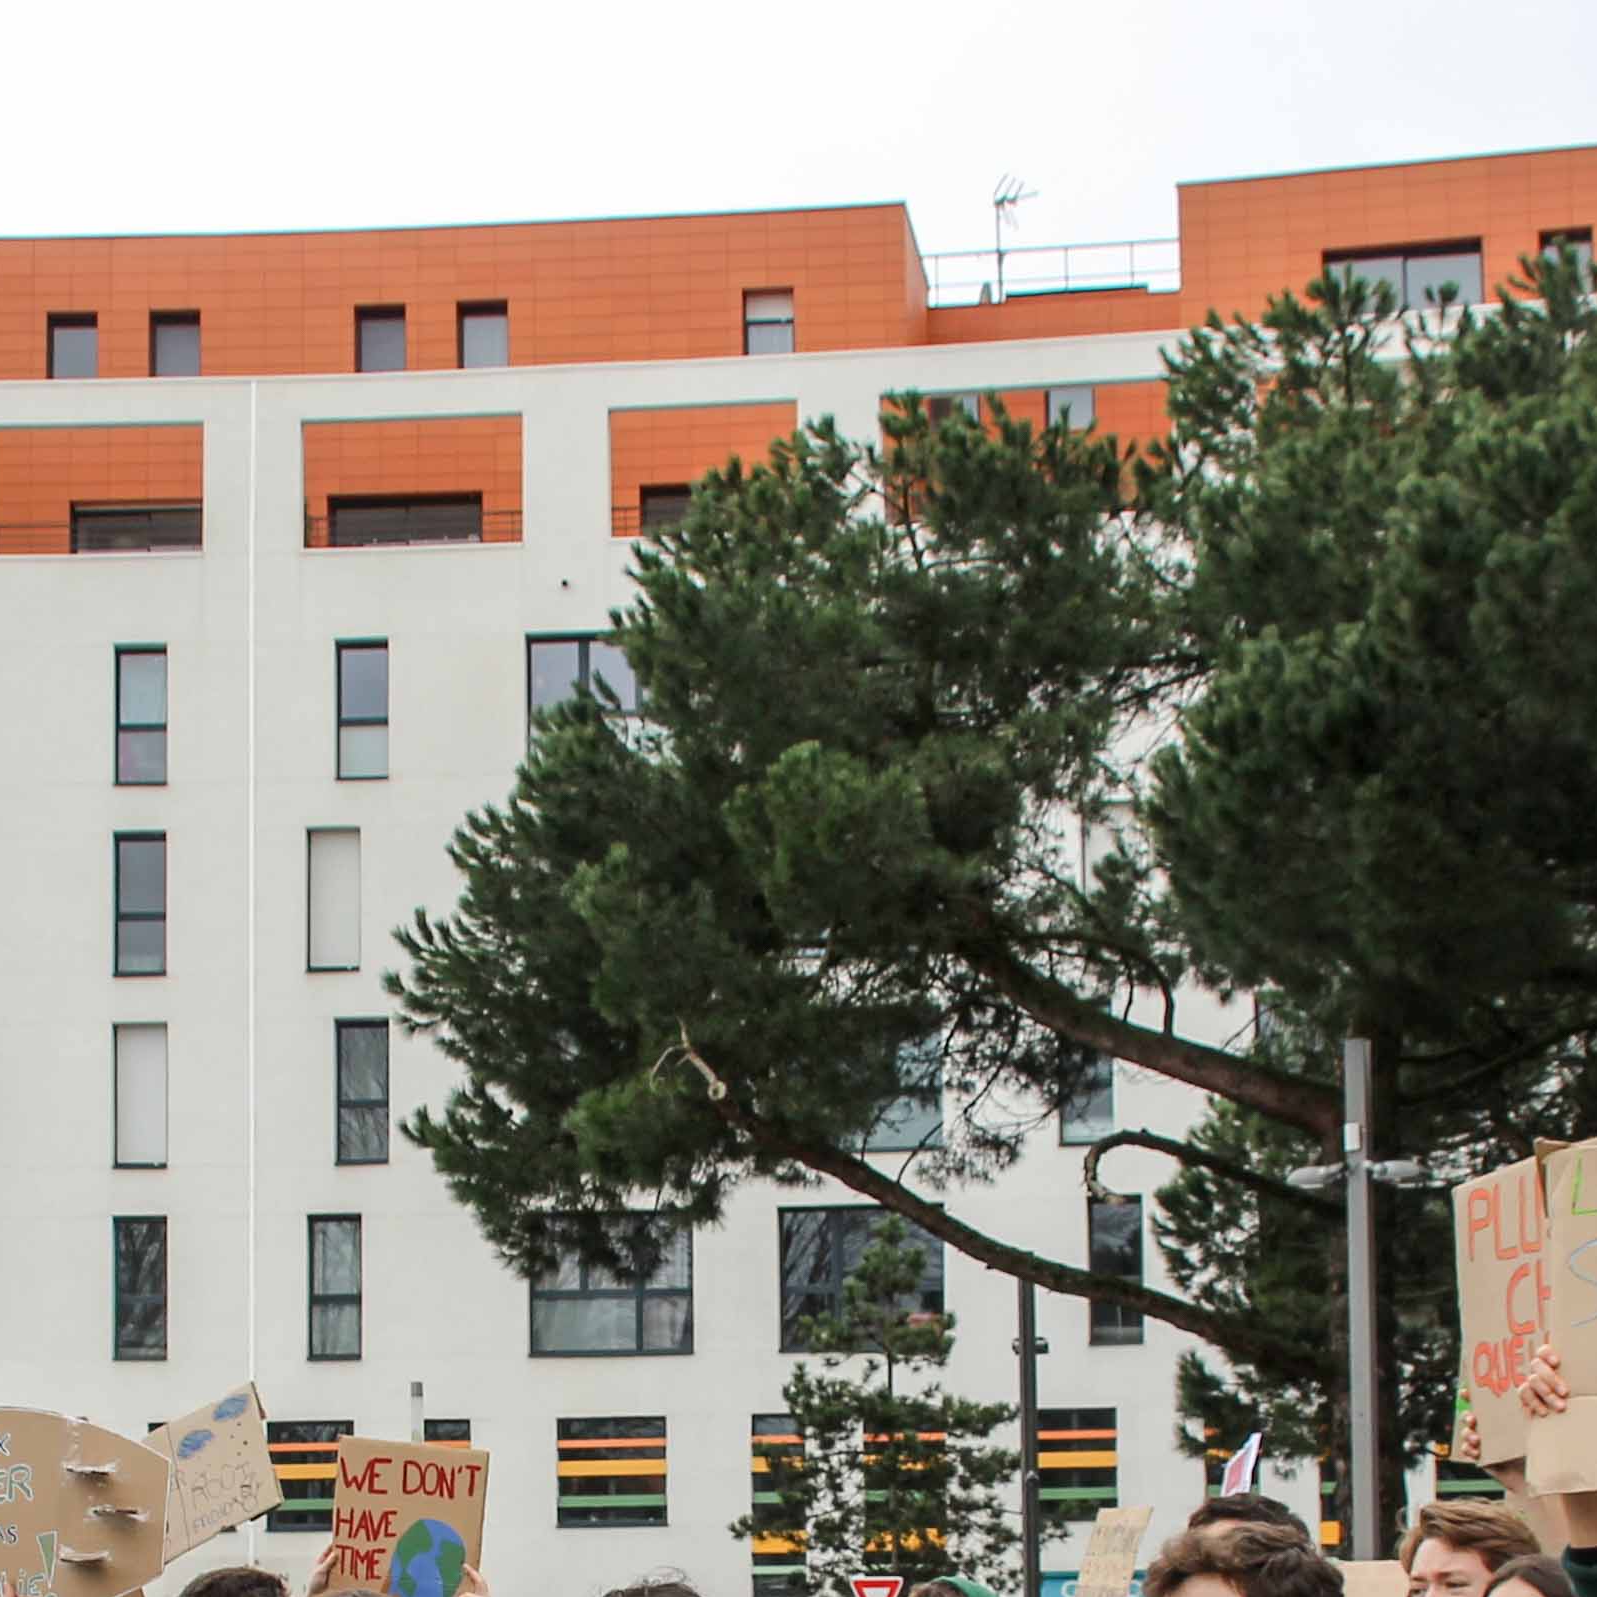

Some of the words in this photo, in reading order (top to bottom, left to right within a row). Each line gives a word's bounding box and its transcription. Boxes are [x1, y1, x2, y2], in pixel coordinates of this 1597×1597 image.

[1467, 1166, 1543, 1262] PLU
[1506, 1259, 1552, 1334] CH
[341, 1457, 393, 1495] WE
[402, 1462, 482, 1500] DON'T
[334, 1507, 398, 1542] HAVE
[335, 1544, 387, 1581] TIME
